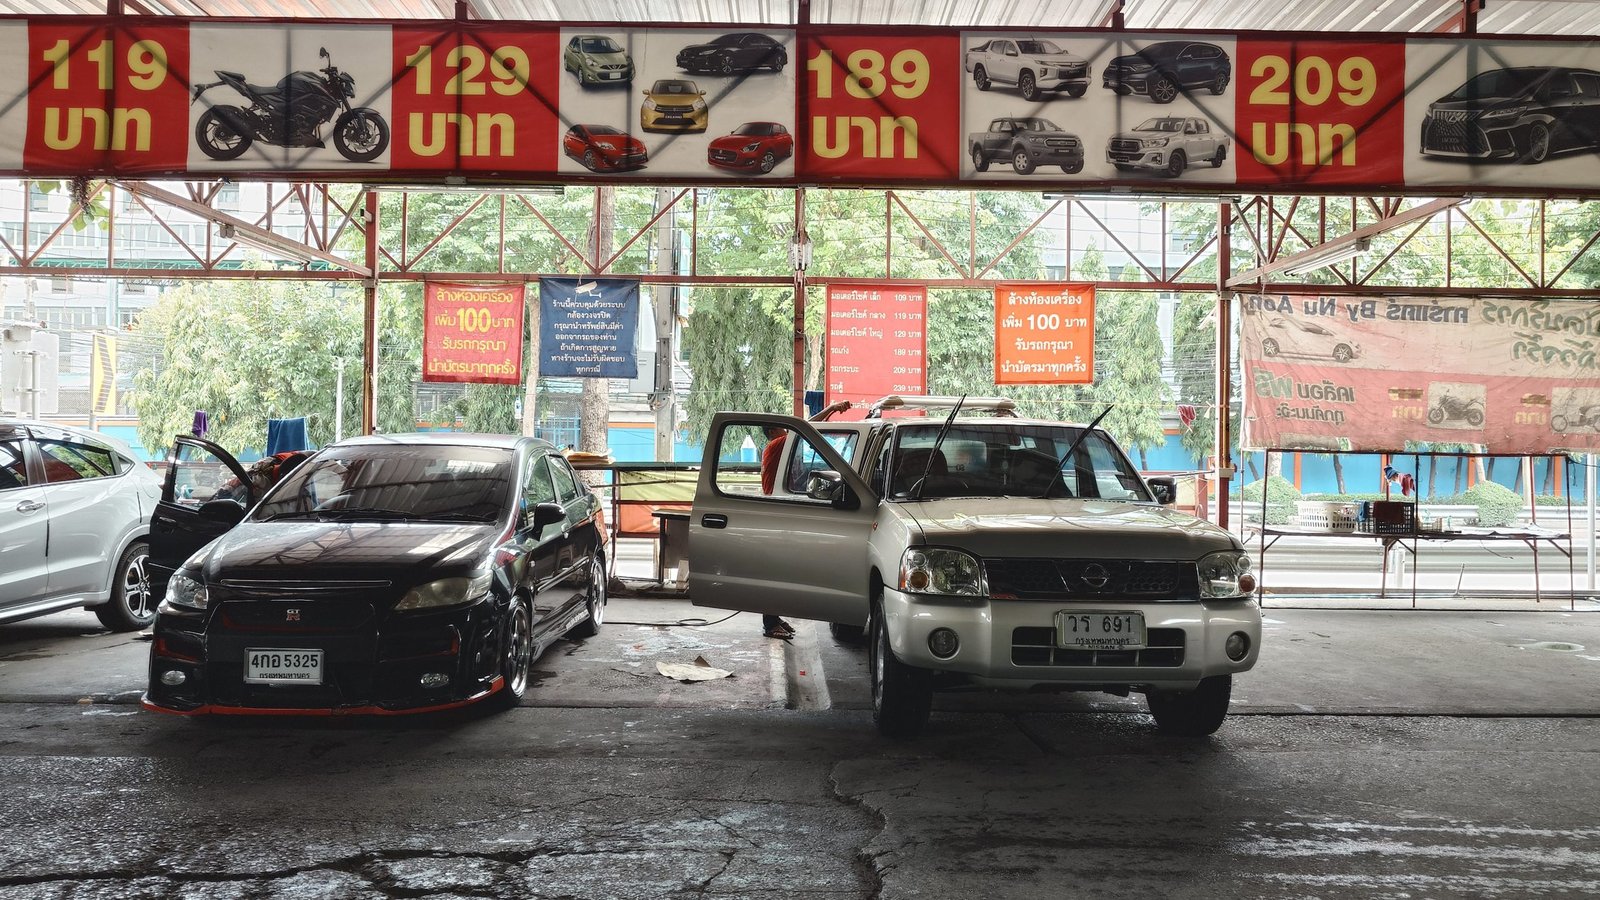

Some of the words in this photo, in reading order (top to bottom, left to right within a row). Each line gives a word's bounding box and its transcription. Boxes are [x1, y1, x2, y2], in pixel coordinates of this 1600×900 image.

[43, 39, 168, 91] 119
[405, 44, 530, 96] 129
[807, 49, 931, 99] 189
[1249, 54, 1377, 107] 209
[43, 107, 152, 152] บาท
[408, 112, 515, 157] บาท
[812, 115, 918, 159] บาท
[1252, 122, 1356, 166] บาท
[435, 310, 456, 326] เพิ่ม
[457, 307, 492, 333] 100
[492, 317, 515, 328] บาท
[1002, 312, 1023, 328] เพิ่ม
[1026, 313, 1060, 330] 100
[1064, 318, 1087, 328] บาท
[1001, 356, 1087, 377] นำบัตรมาทุกครั้ง
[1015, 338, 1074, 354] รับรถกรุณา
[1103, 615, 1131, 633] 691
[251, 654, 281, 668] 4กอ
[284, 654, 319, 668] 5325
